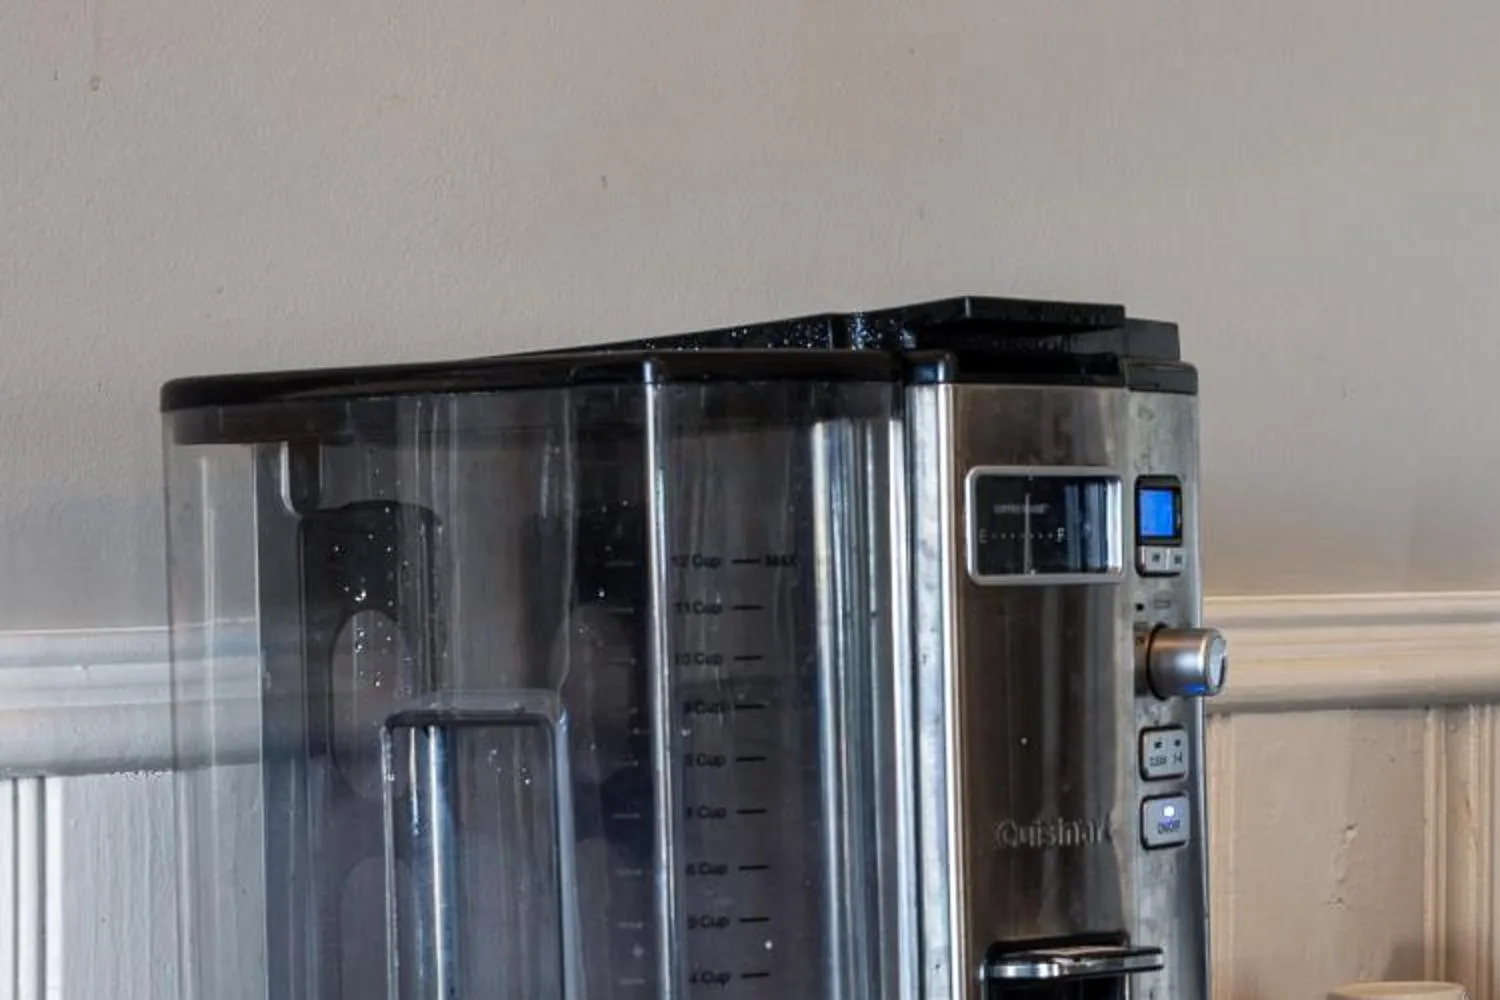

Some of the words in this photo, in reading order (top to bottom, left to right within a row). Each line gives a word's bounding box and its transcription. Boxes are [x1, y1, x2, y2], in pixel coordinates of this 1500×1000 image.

[692, 553, 723, 570] Cup
[693, 600, 723, 616] Cup
[693, 651, 723, 667] Cup
[696, 752, 727, 768] Cup
[696, 804, 727, 820] Cup
[698, 862, 729, 877] Cup
[700, 914, 730, 930] Cup
[701, 970, 731, 986] Cup
